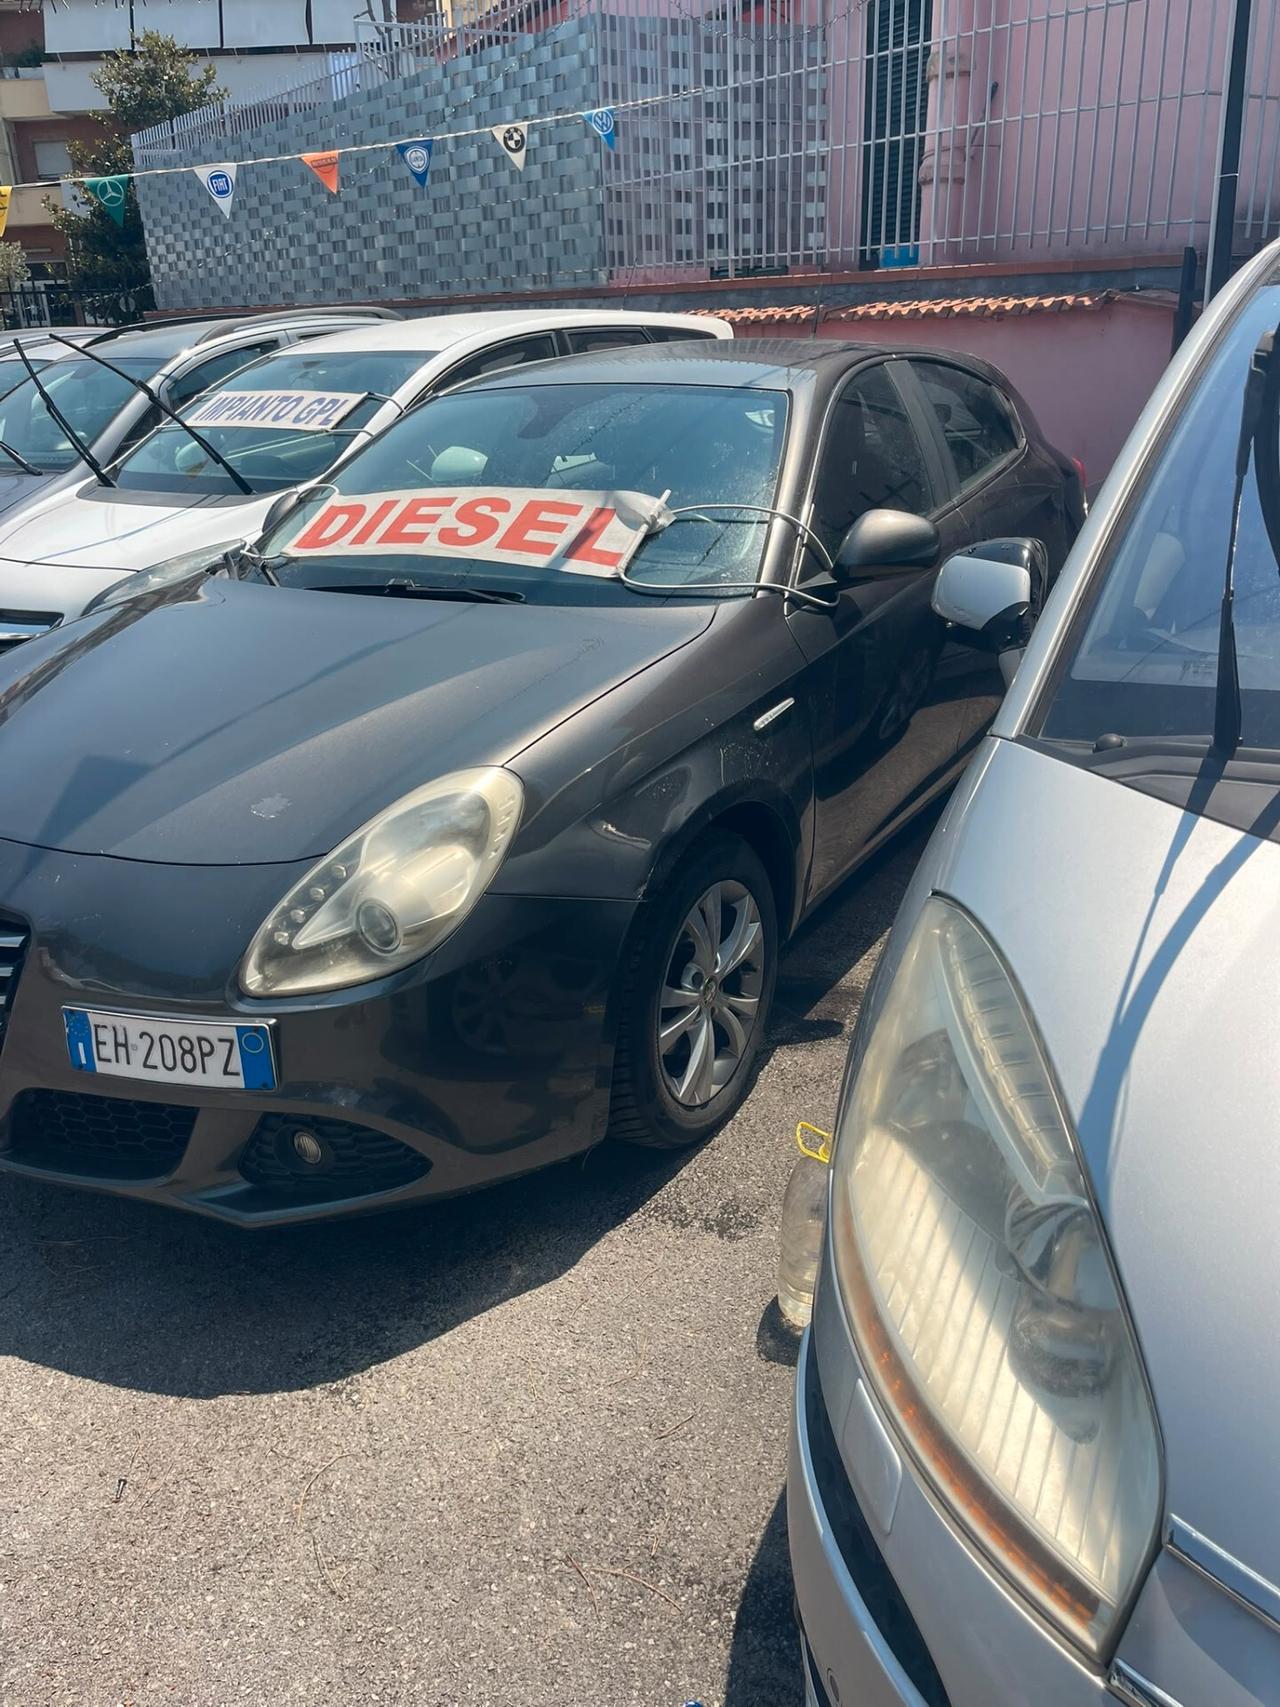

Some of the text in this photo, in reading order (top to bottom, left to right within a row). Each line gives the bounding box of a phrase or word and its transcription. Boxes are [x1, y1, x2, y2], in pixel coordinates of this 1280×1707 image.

[195, 395, 349, 426] IMPIANTO GPL
[293, 496, 625, 567] DIESEL
